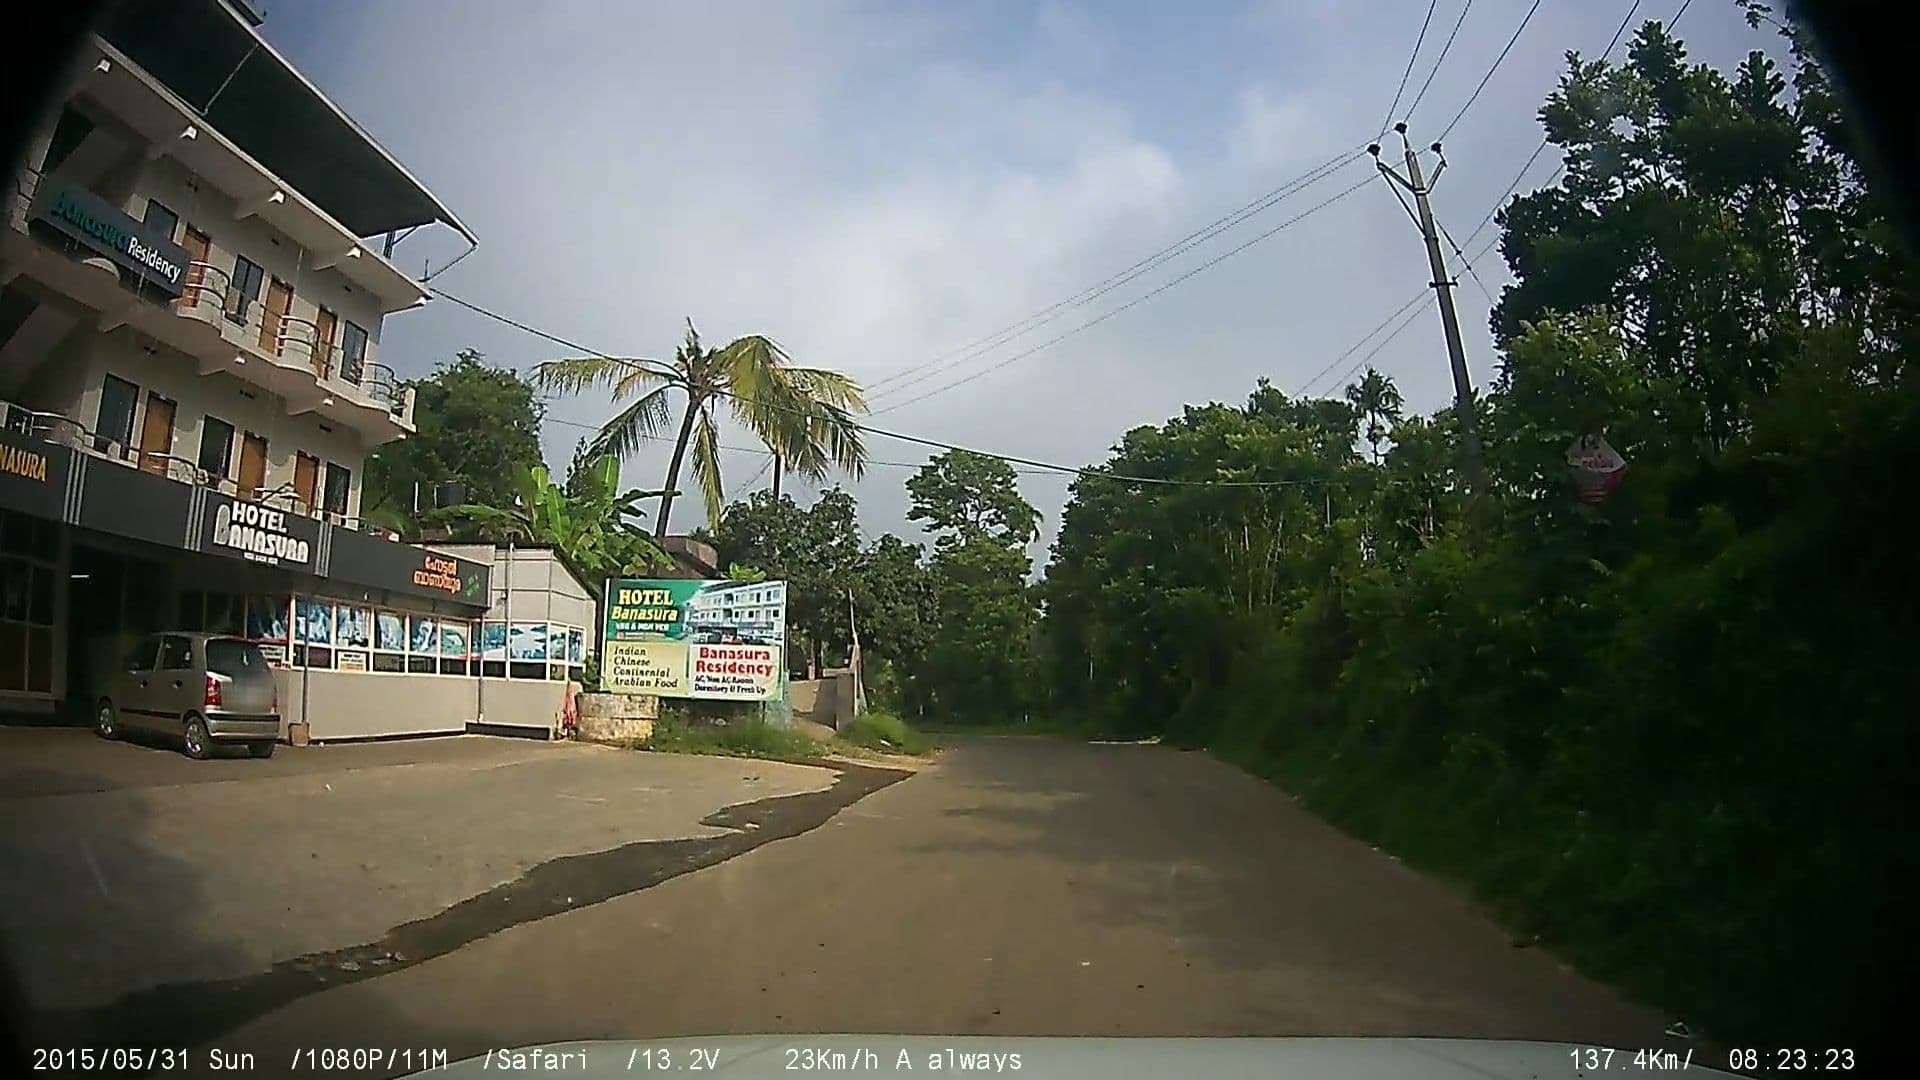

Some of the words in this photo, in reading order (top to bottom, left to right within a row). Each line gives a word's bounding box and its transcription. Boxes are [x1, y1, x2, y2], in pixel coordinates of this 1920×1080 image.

[127, 236, 182, 284] Residency
[231, 500, 288, 533] HOTEL
[213, 504, 309, 564] BANASURA
[619, 589, 674, 606] HOTEL
[611, 606, 678, 622] Banasura
[614, 646, 646, 656] Indian
[699, 647, 771, 661] Banasura
[613, 656, 651, 666] Chinese
[695, 660, 773, 677] Residency
[614, 677, 652, 687] Arabian
[654, 678, 678, 688] Food
